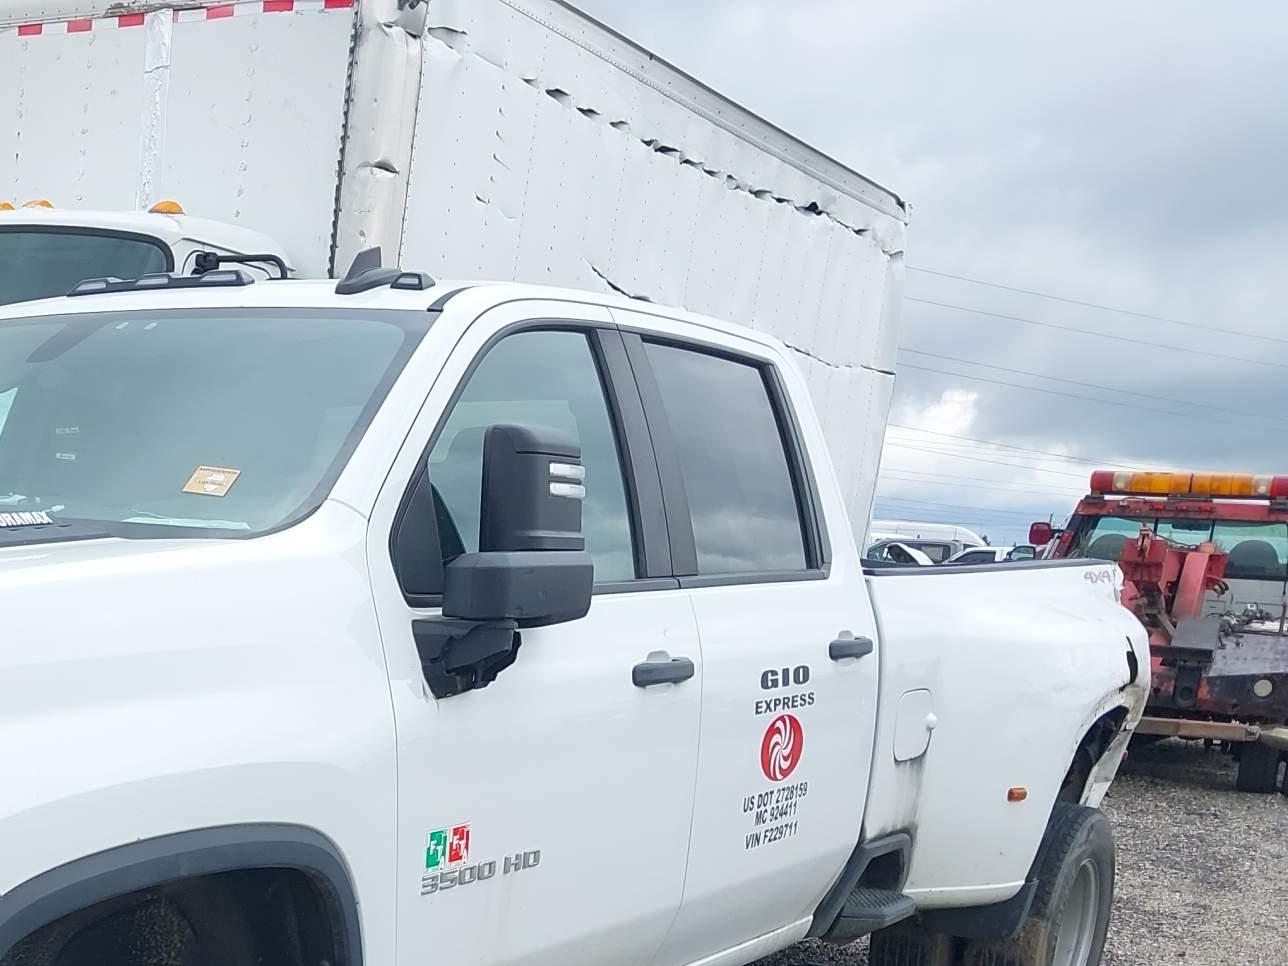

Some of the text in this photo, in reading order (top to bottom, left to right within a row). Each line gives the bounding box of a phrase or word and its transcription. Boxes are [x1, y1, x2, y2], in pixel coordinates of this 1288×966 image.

[760, 665, 810, 690] GIO
[754, 692, 815, 715] EXPRESS
[743, 781, 808, 813] US DOT 2728159
[754, 801, 798, 827] MC 924411
[745, 820, 798, 850] VIN F229711
[420, 849, 541, 897] 3500 HD
